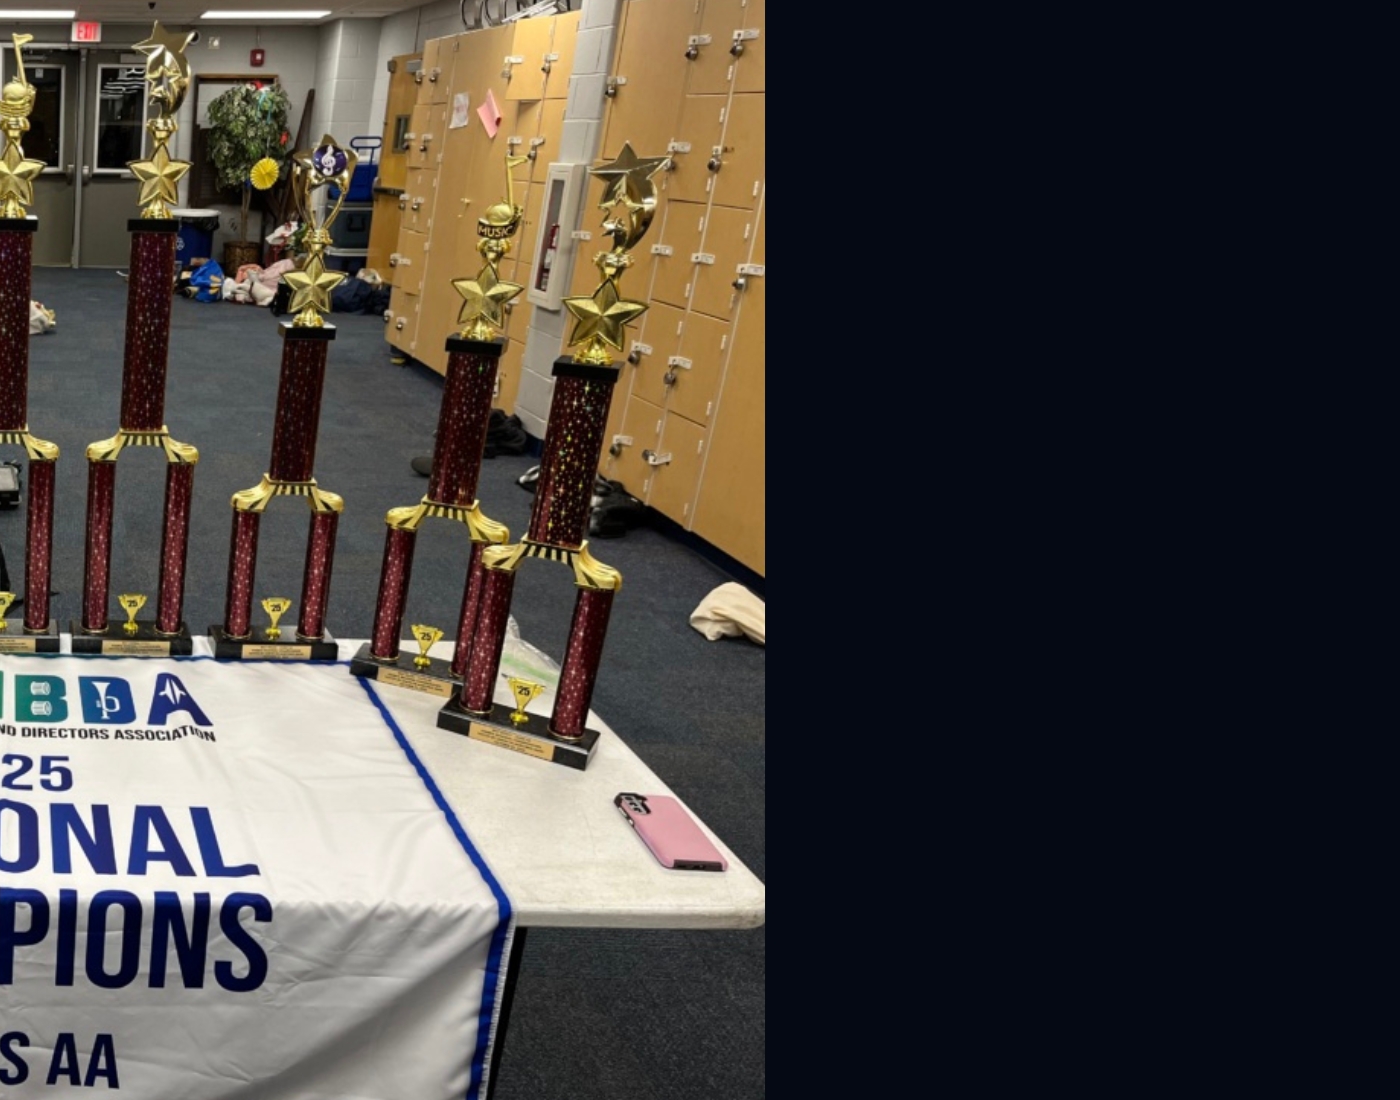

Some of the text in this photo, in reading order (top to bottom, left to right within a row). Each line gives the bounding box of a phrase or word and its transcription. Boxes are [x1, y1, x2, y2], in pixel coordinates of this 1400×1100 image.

[77, 21, 99, 40] EXIT
[479, 225, 513, 237] MUSIC
[21, 727, 110, 740] DIRECTORS
[114, 724, 217, 742] ASSOCIATION
[46, 1032, 120, 1089] AA
